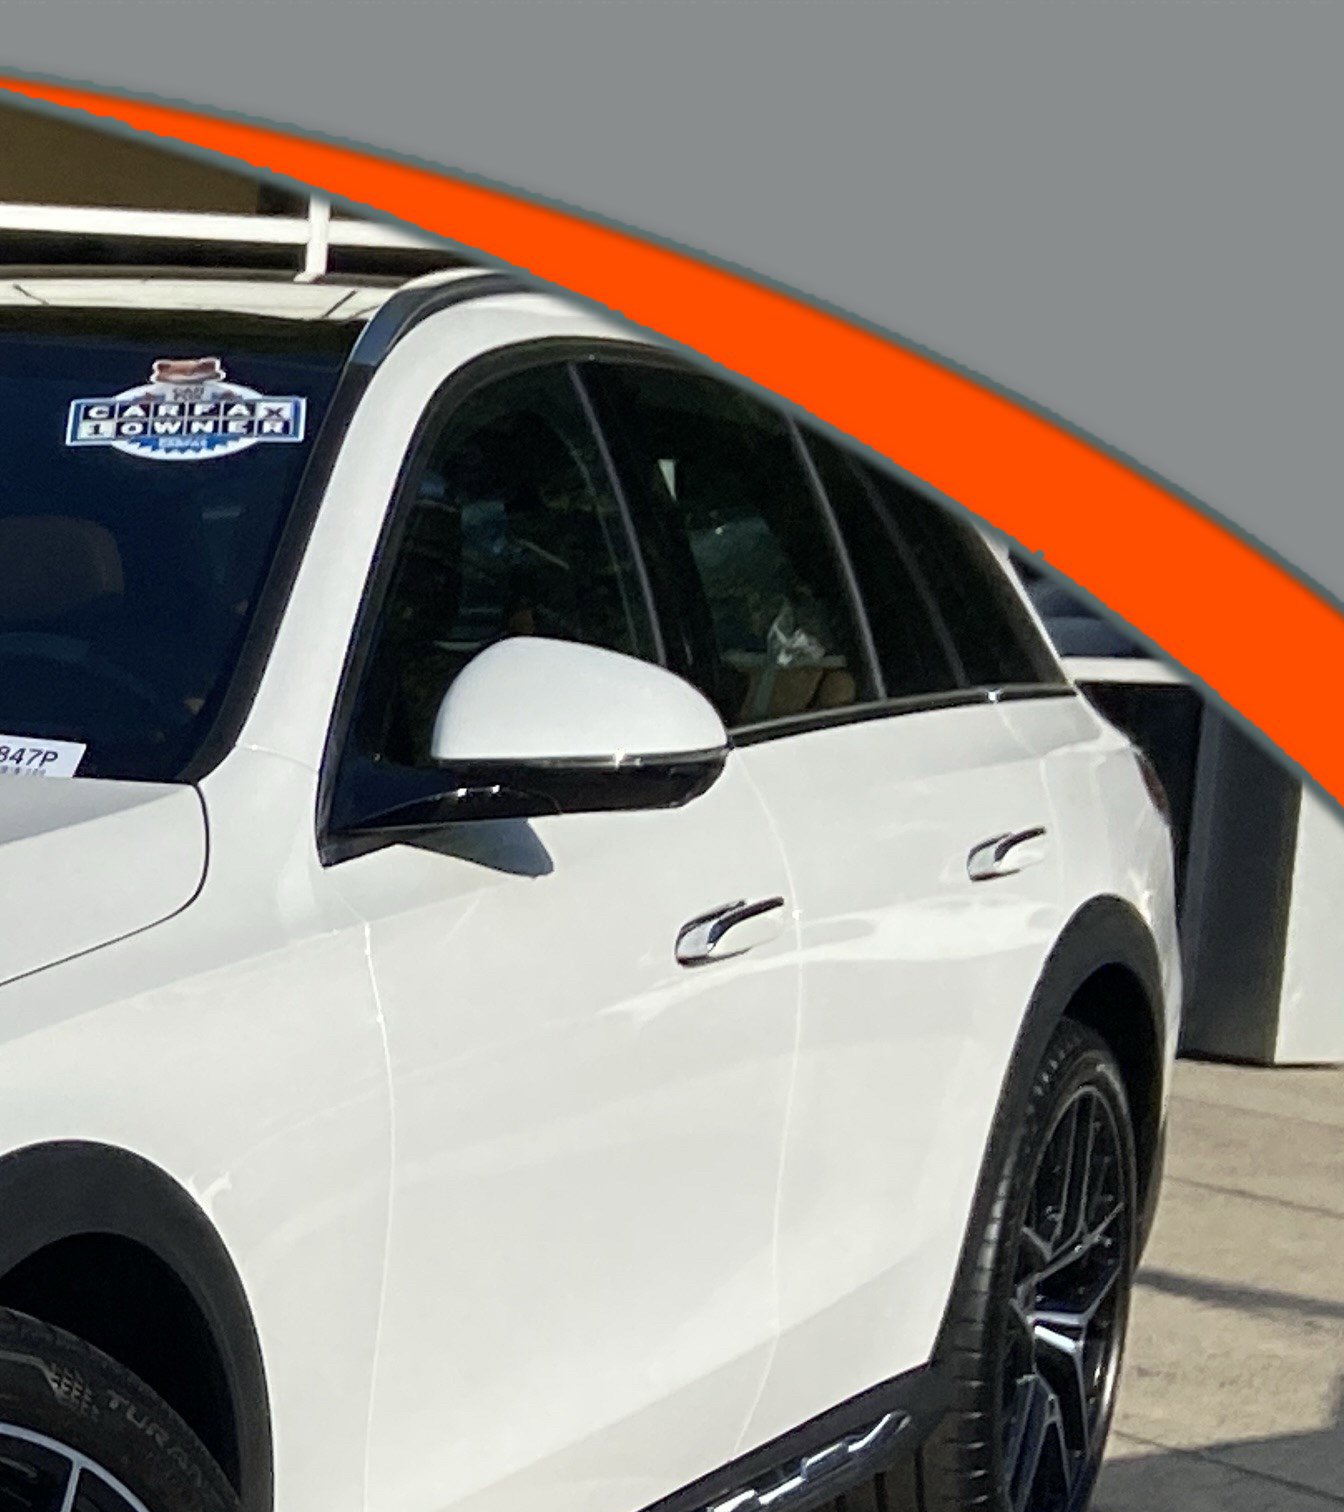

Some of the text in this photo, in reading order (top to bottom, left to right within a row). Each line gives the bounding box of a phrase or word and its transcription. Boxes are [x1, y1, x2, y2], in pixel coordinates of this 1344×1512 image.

[87, 403, 285, 420] CARFAX
[89, 420, 285, 436] 1 OWNER
